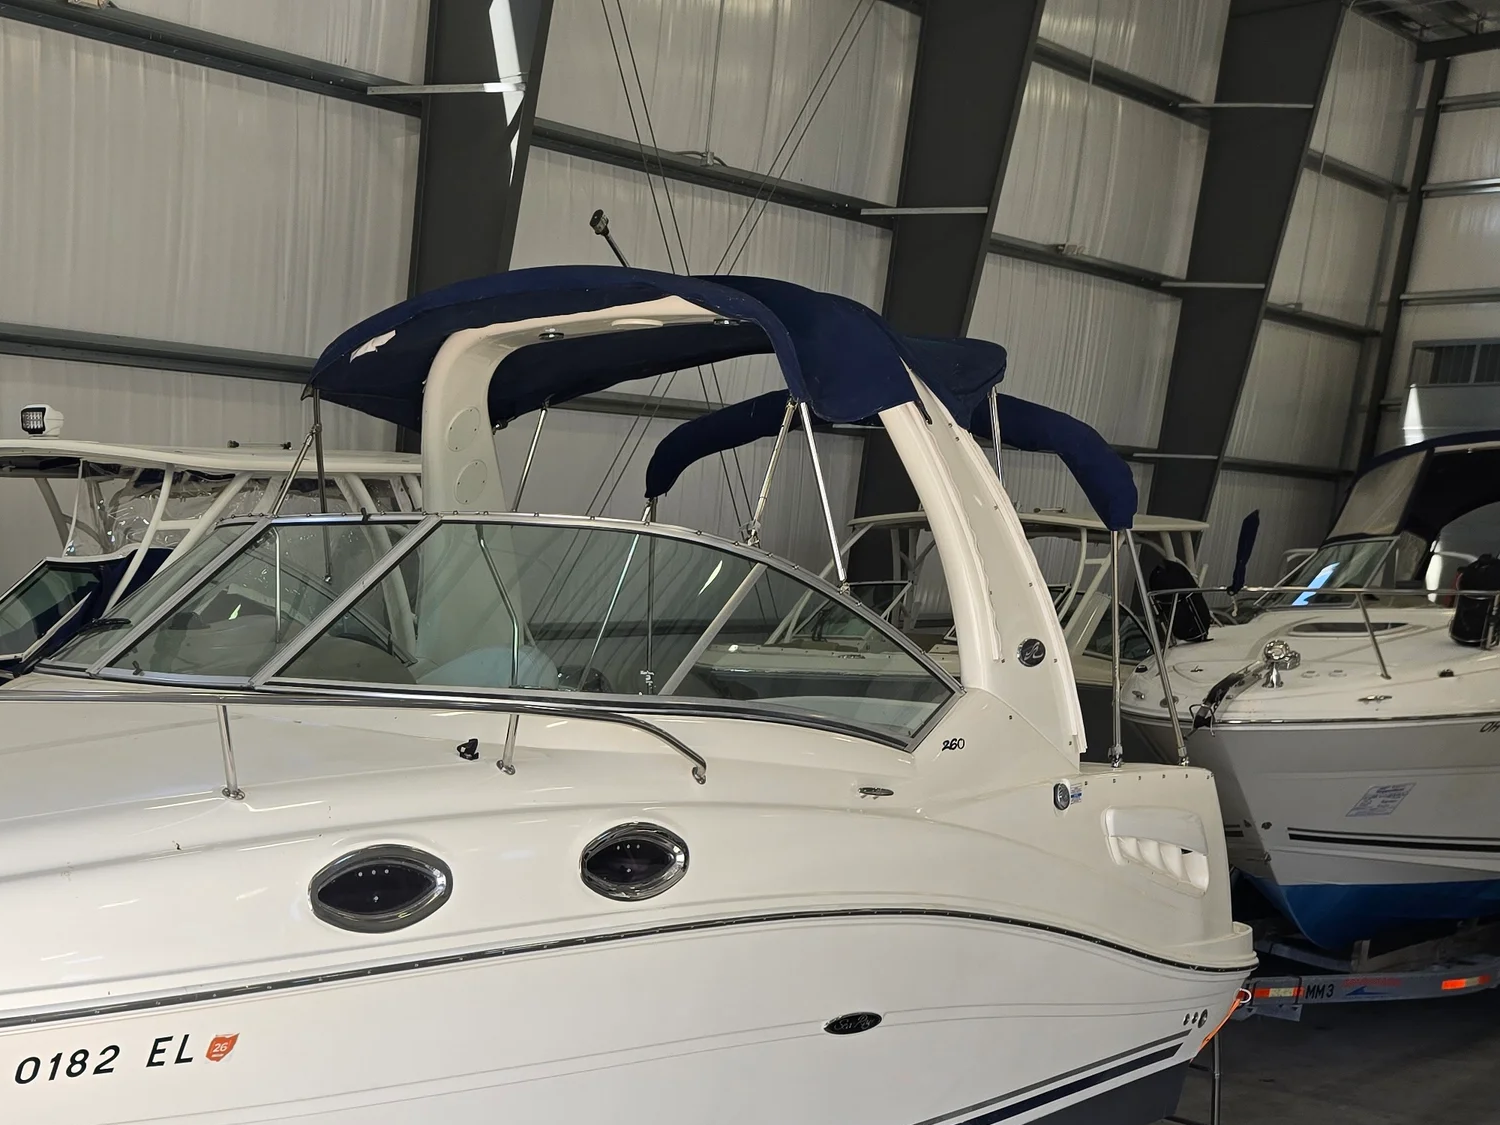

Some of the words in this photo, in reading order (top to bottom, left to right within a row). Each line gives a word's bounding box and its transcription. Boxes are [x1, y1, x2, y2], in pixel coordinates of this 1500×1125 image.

[941, 738, 965, 751] 260
[212, 1042, 228, 1053] 26
[14, 1044, 120, 1084] 0182
[146, 1034, 194, 1067] EL
